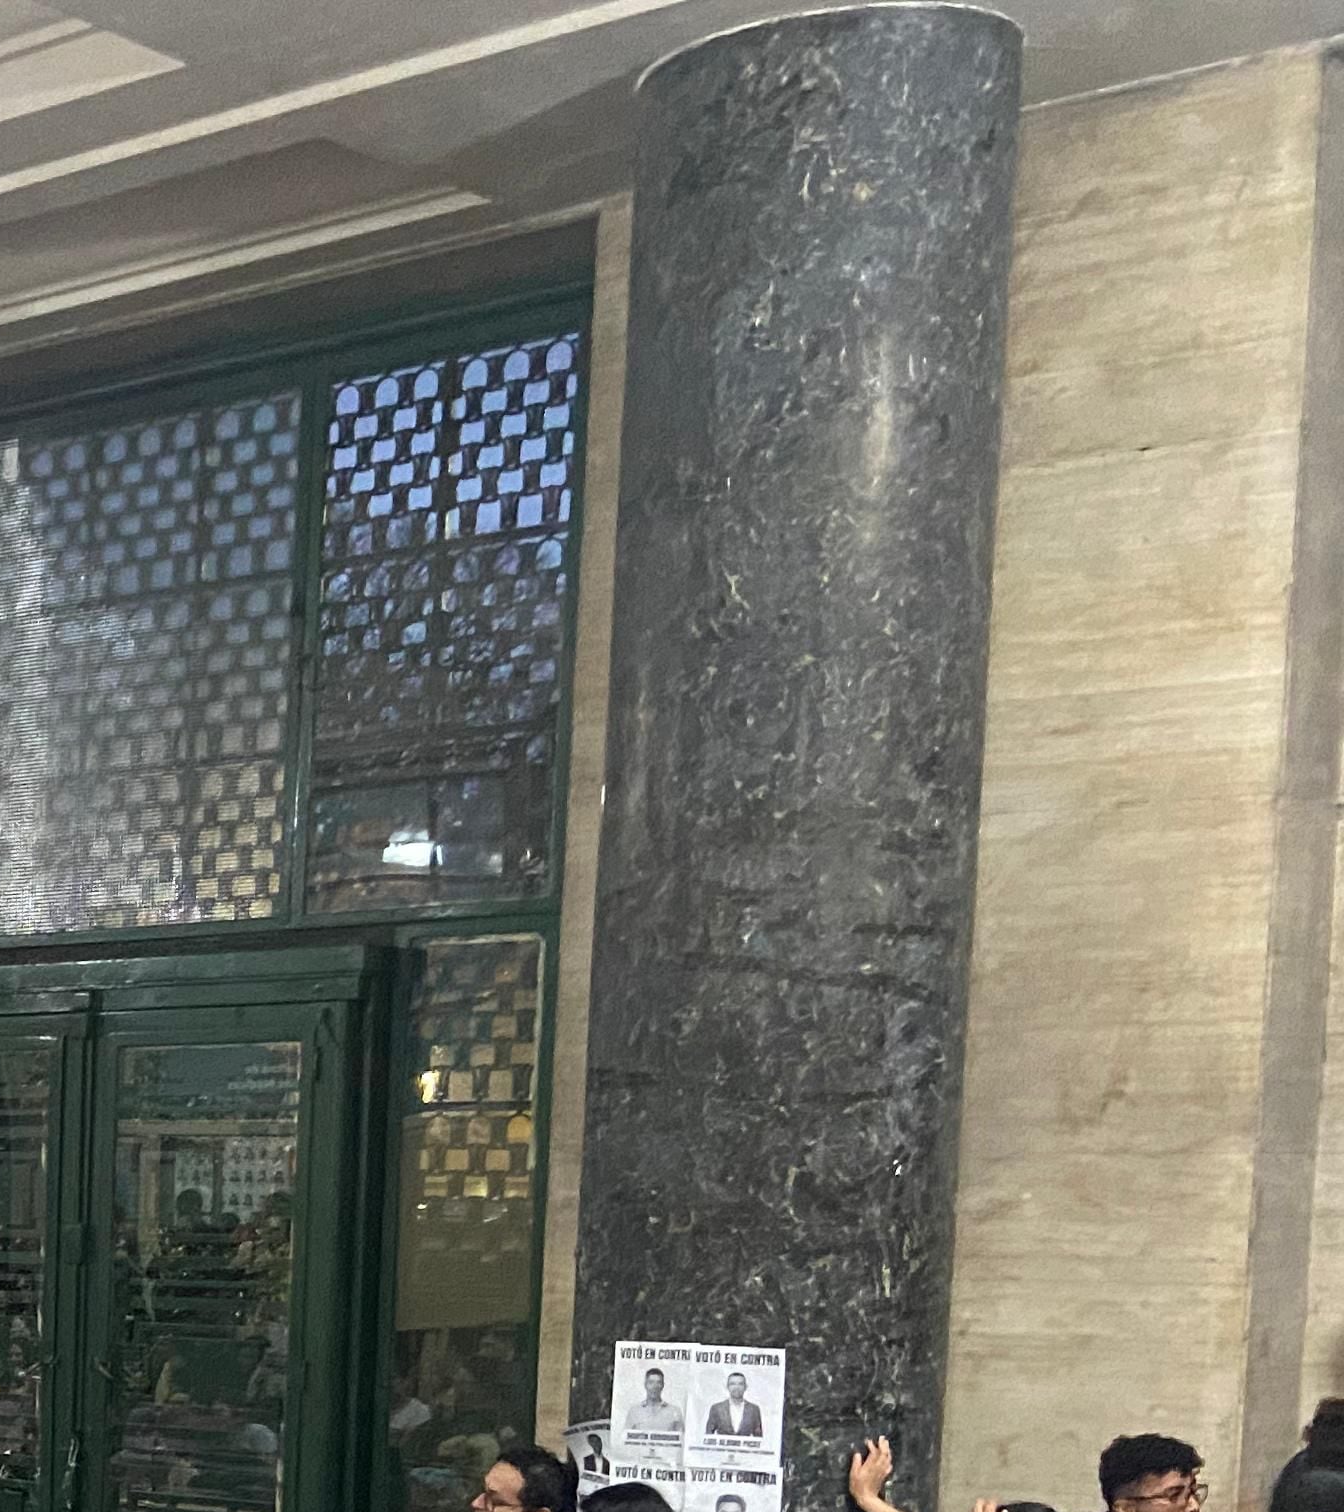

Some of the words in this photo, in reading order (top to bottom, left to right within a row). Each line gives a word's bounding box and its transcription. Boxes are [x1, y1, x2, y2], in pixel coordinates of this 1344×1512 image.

[620, 1345, 643, 1359] VOTÓ
[645, 1348, 655, 1359] EN
[696, 1351, 721, 1363] VOTÓ
[724, 1352, 737, 1364] EN
[740, 1354, 779, 1366] CONTRA
[615, 1465, 638, 1478] VOTÓ
[640, 1467, 652, 1480] EN
[691, 1468, 716, 1482] VOTÓ
[720, 1471, 733, 1483] EN
[736, 1471, 777, 1485] CONTRA
